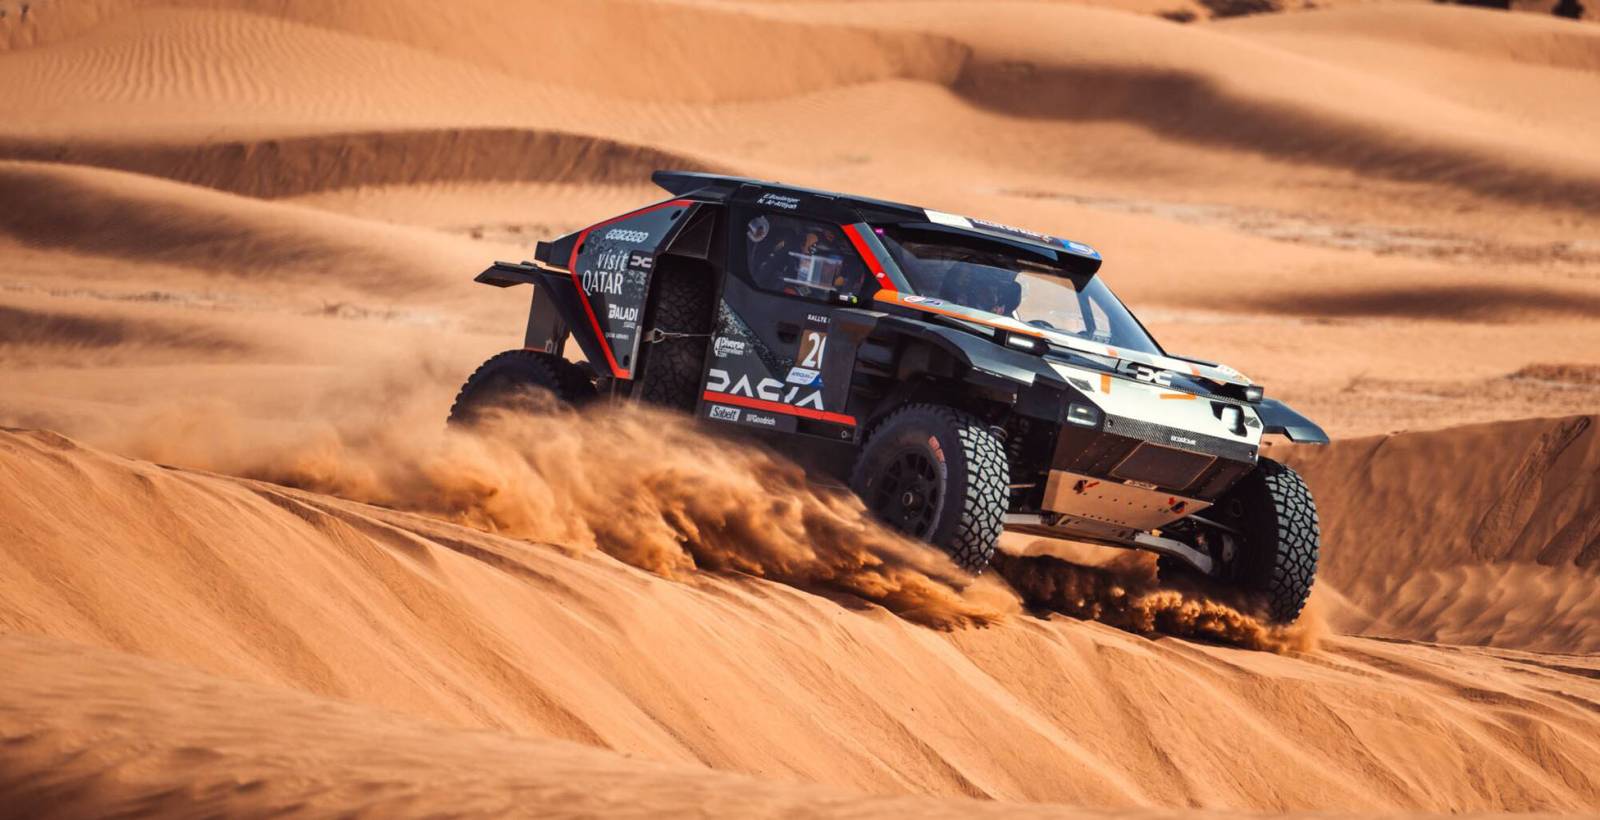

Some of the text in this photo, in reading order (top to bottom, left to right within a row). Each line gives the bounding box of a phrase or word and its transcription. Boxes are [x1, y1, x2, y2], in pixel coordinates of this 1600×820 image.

[597, 249, 629, 271] visit
[582, 269, 624, 296] QATAR
[608, 303, 639, 321] BALADI
[720, 336, 745, 350] Diverse
[706, 368, 824, 411] DACIA
[712, 406, 737, 421] Sabelt
